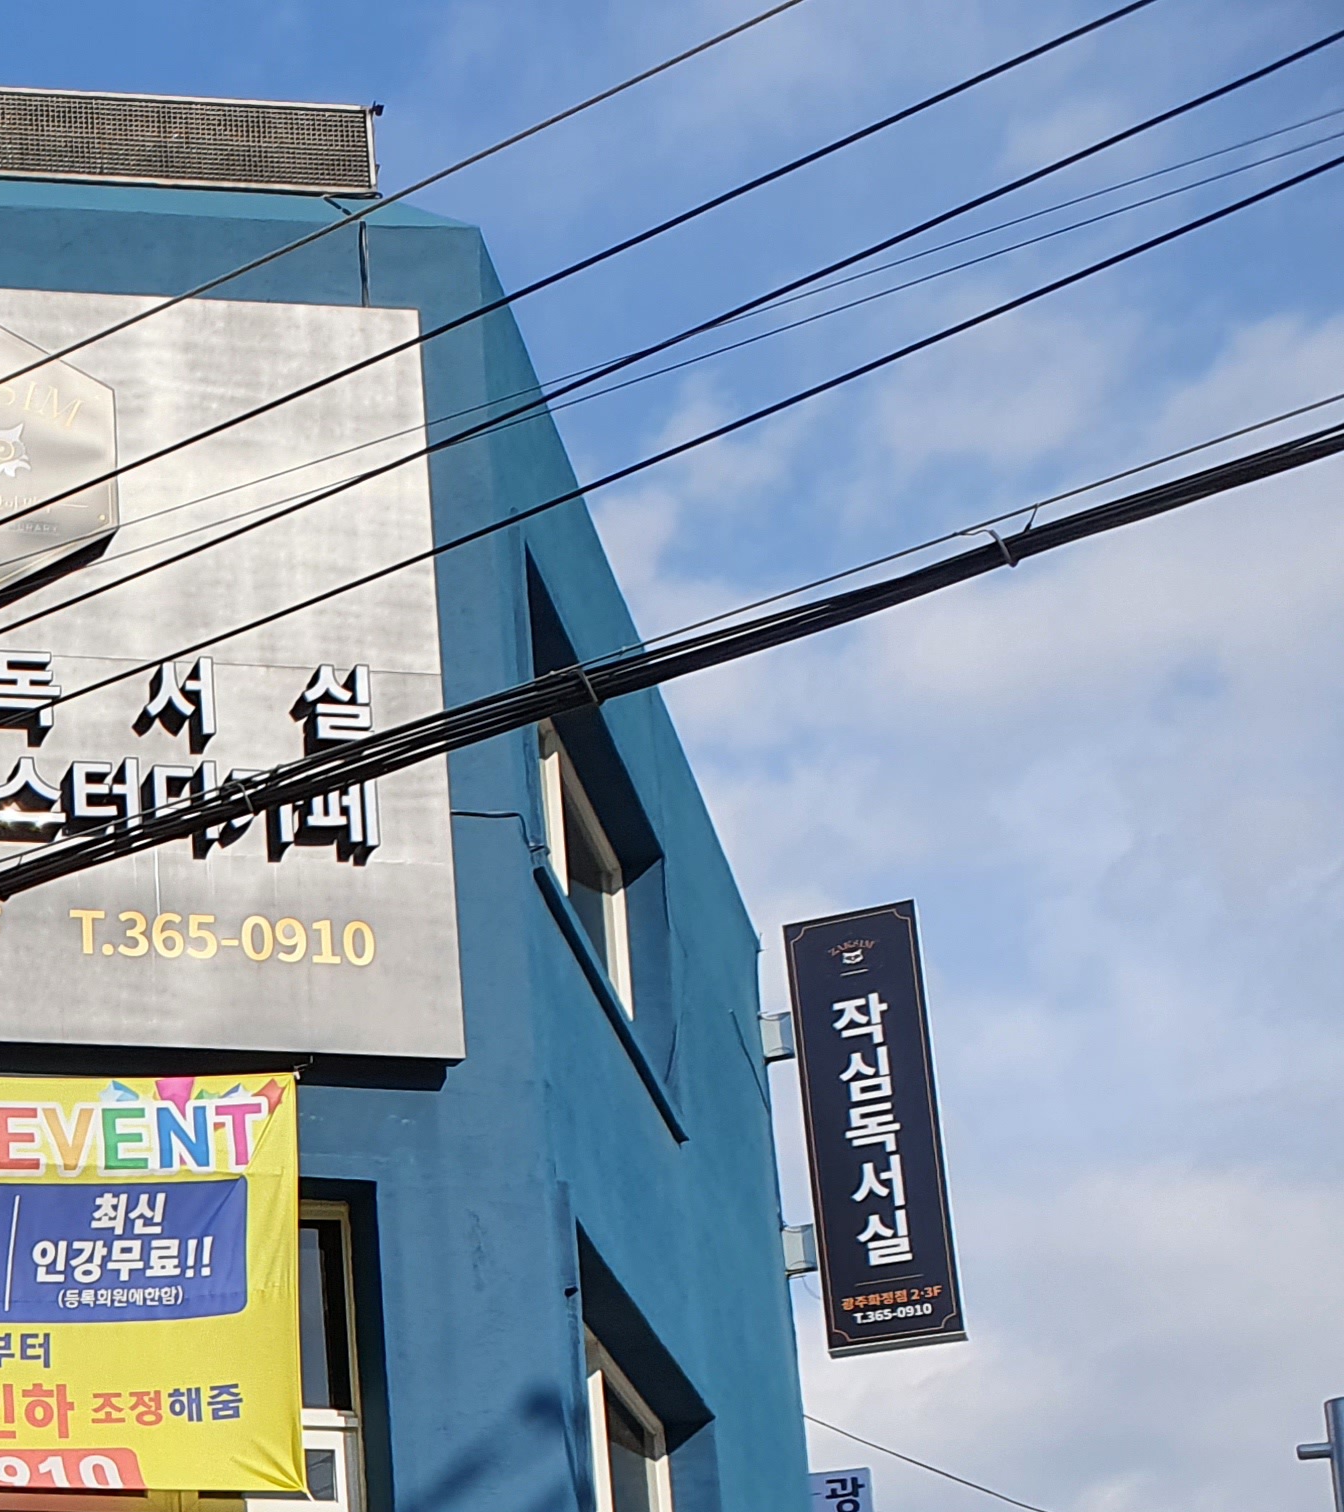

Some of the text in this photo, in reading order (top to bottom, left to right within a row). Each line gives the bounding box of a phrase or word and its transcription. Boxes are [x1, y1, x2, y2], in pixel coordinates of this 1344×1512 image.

[70, 907, 376, 967] T.365-0910
[831, 992, 914, 1267] 작심독서실
[94, 1193, 166, 1236] 최신
[32, 1237, 212, 1284] 인강무료!!
[841, 1283, 944, 1311] 광주화정점 2·3F
[853, 1302, 933, 1325] T.365-0910
